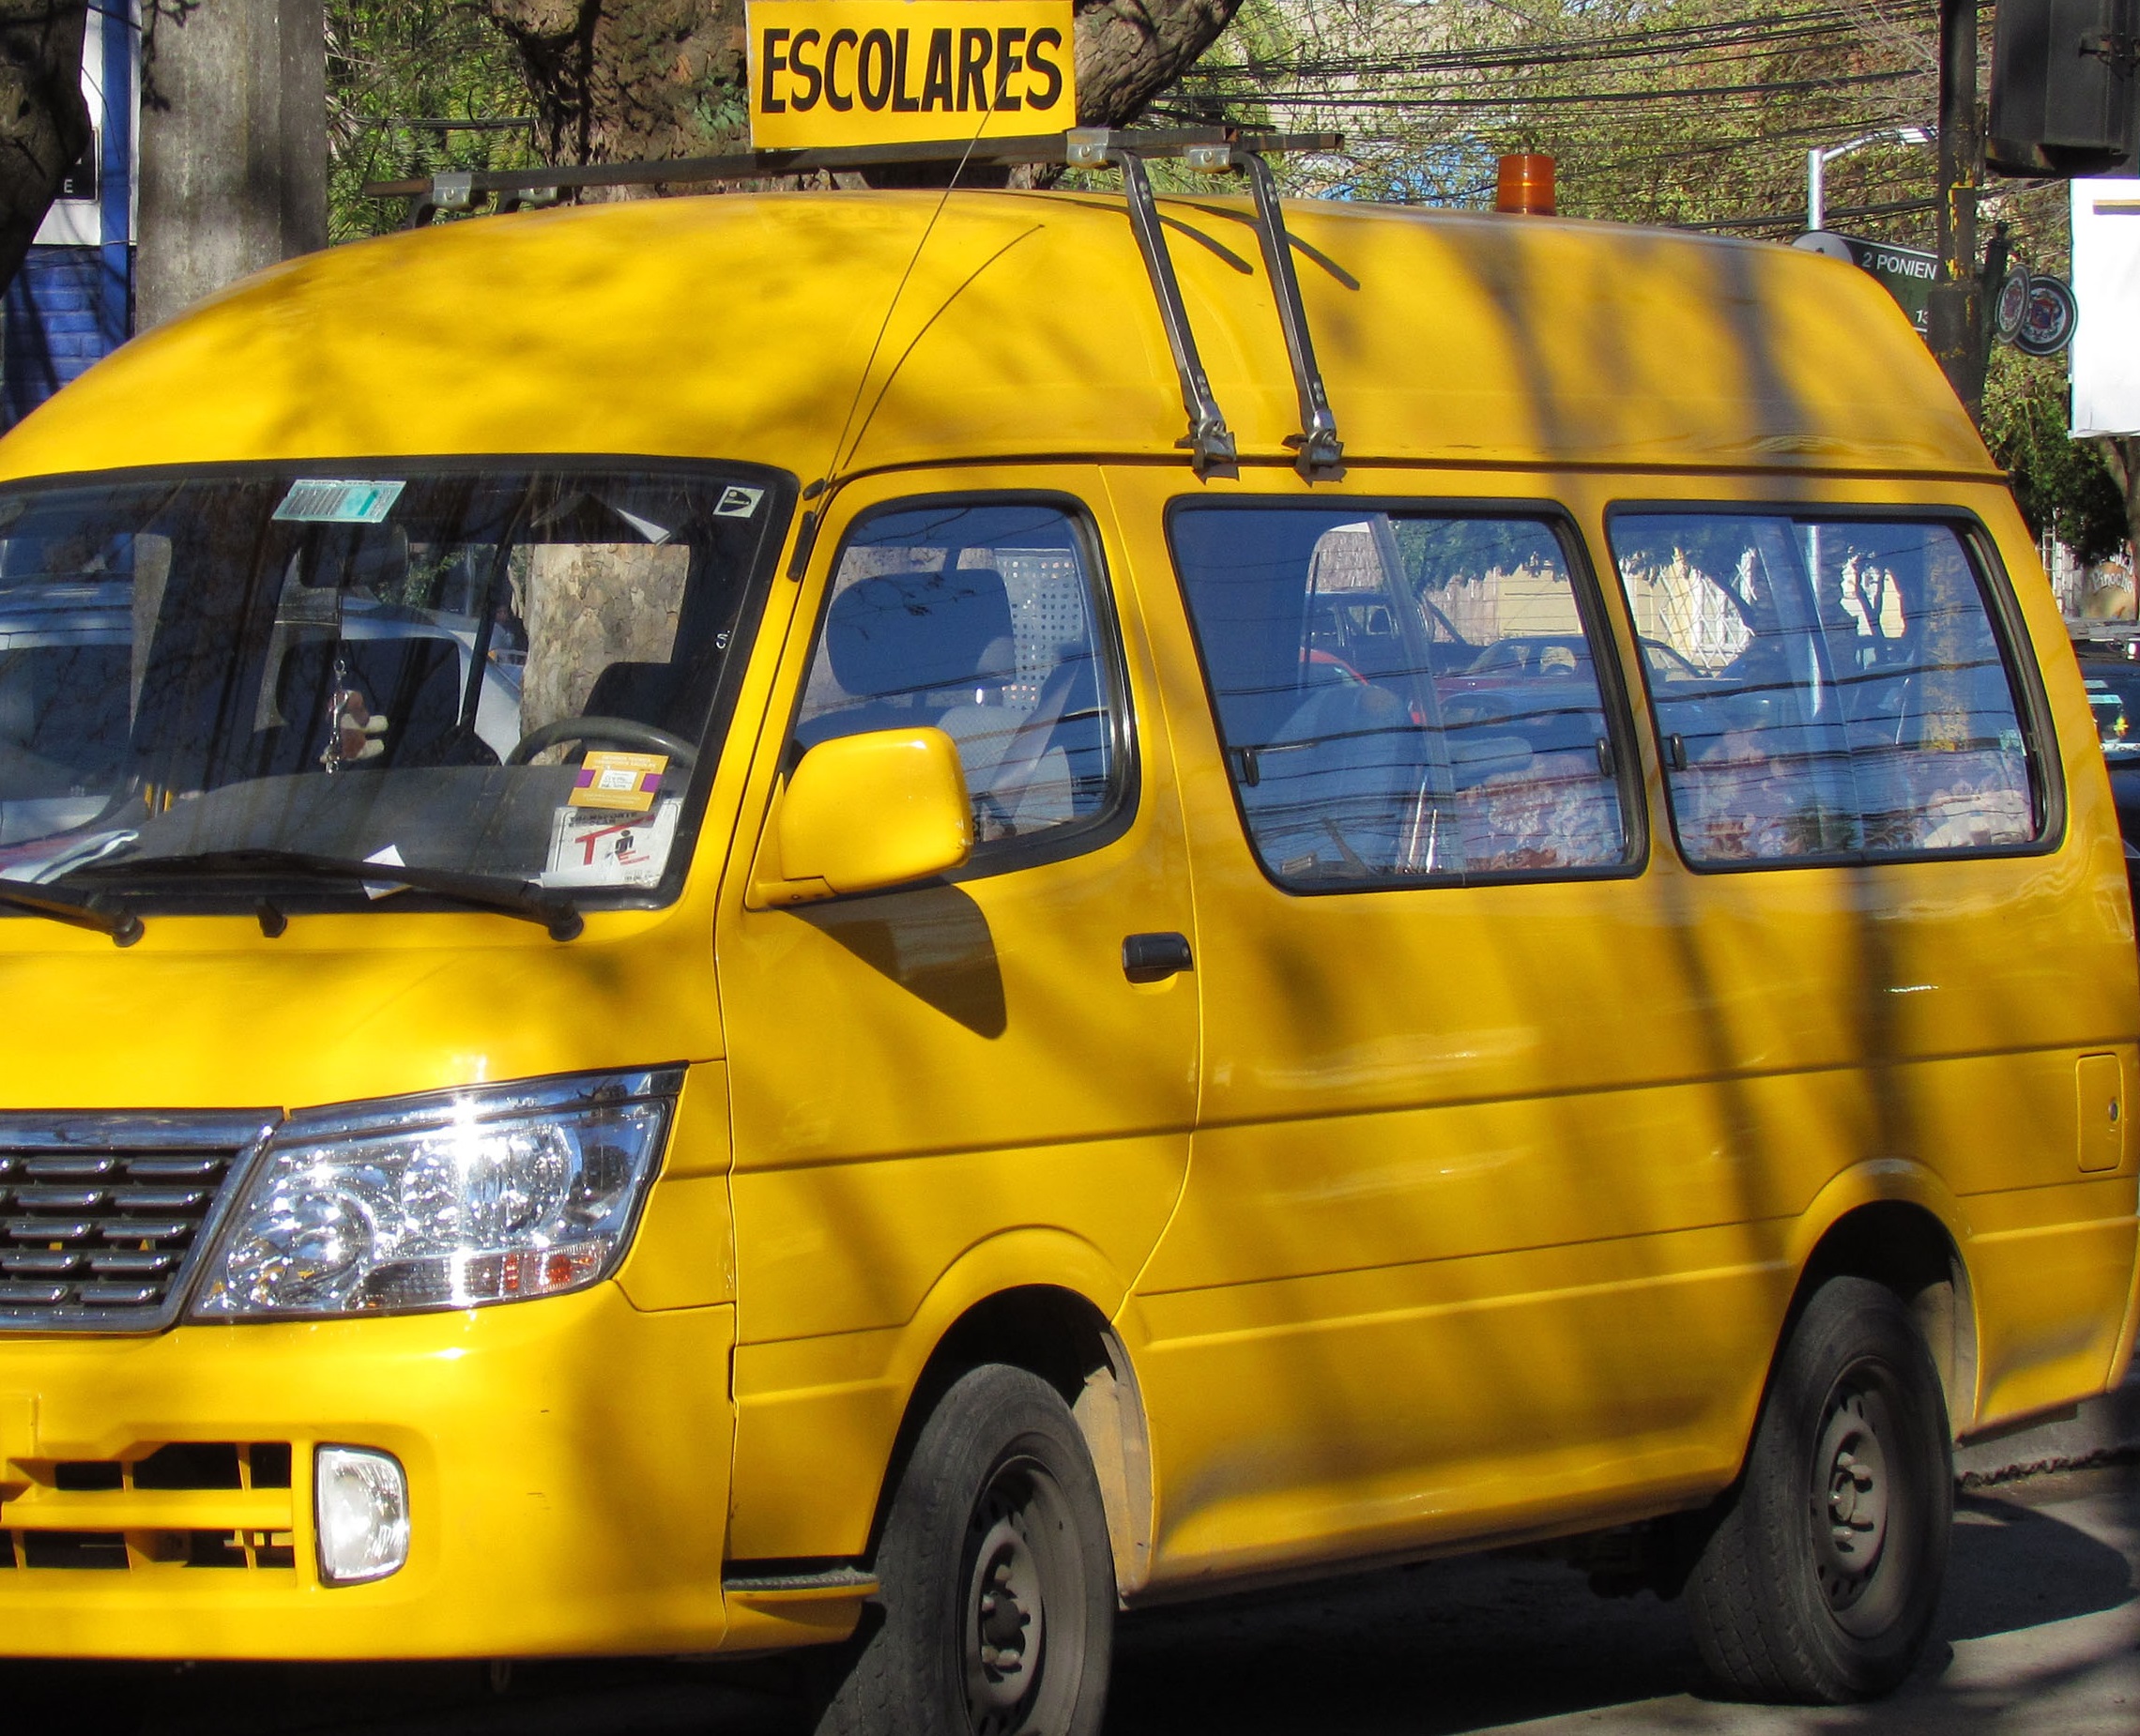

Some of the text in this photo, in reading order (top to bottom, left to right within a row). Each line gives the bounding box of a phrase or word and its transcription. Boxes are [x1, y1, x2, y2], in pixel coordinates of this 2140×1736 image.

[760, 27, 1062, 114] ESCOLARES
[1861, 251, 1937, 280] 2 PONIEN
[2091, 569, 2133, 594] Pinocho
